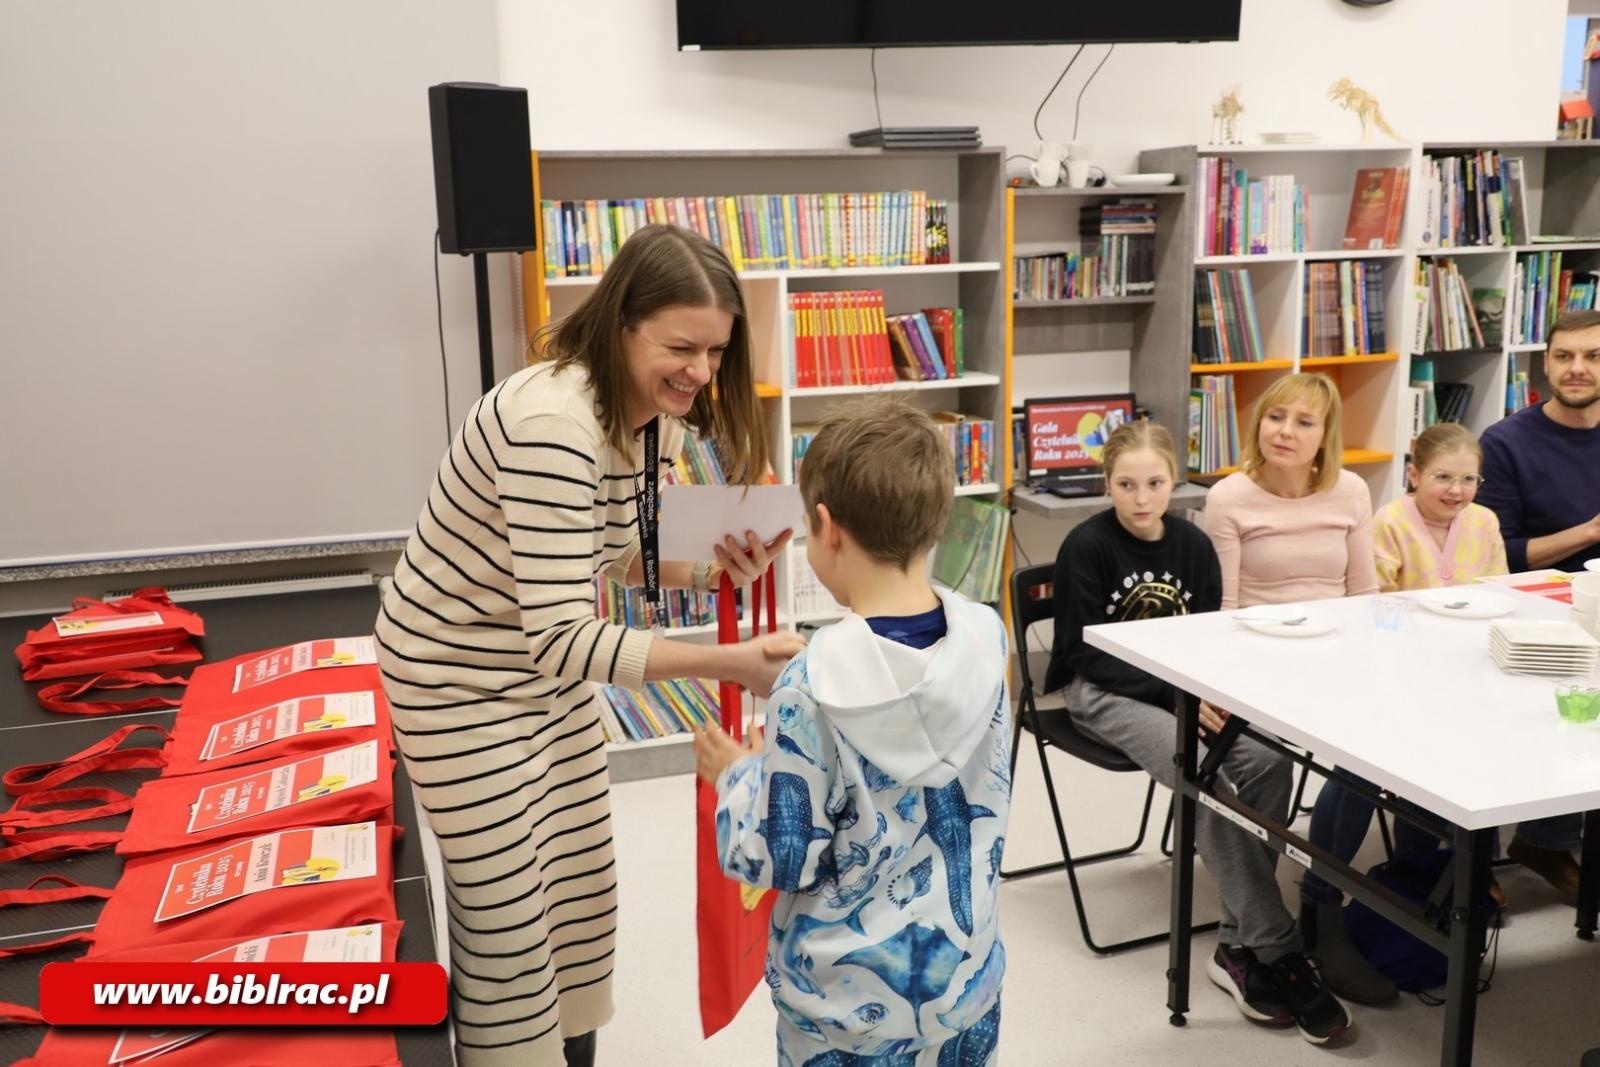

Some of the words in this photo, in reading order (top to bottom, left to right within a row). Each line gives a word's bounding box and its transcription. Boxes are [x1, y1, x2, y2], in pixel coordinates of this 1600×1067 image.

[1032, 420, 1058, 434] Gala
[646, 432, 654, 473] Biblioteka
[1033, 447, 1062, 461] Roku
[215, 786, 238, 820] Czytelnika
[231, 797, 250, 815] Roku
[186, 862, 213, 905] Czytelnika
[205, 873, 227, 898] Roku
[216, 854, 234, 874] 2025
